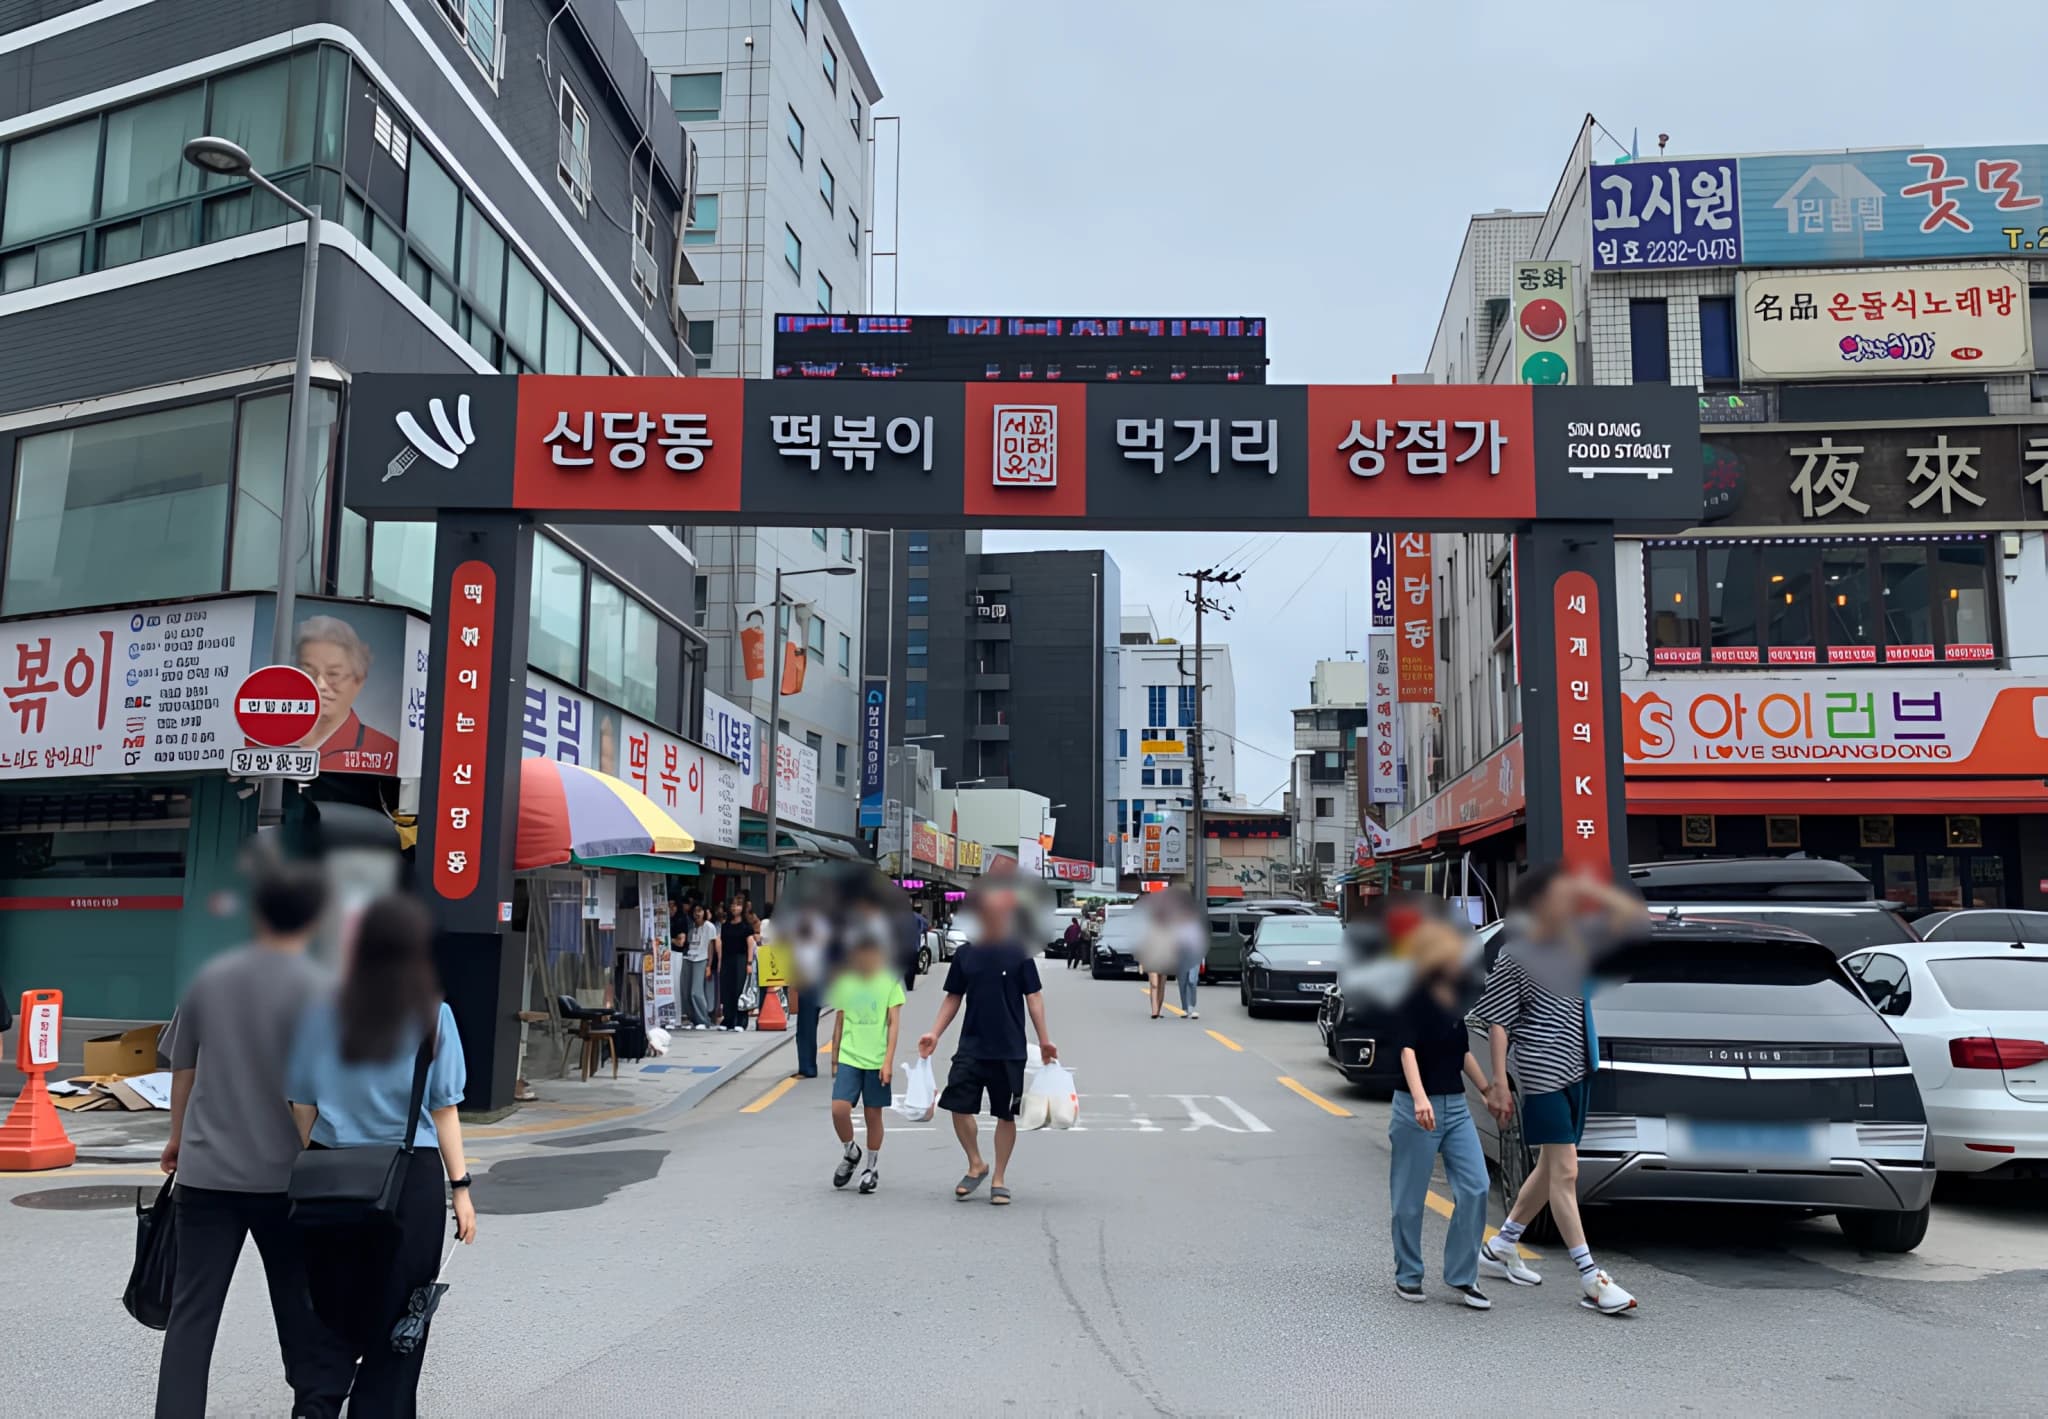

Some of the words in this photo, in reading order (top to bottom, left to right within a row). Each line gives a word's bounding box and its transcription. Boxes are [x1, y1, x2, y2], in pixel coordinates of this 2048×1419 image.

[1593, 166, 1733, 235] 고시원
[1754, 292, 1819, 323] 名品
[541, 410, 714, 471] 신당동
[768, 414, 934, 472] 떡볶이
[1115, 417, 1279, 476] 먹거리
[1337, 417, 1509, 478] 상점가
[1568, 443, 1611, 459] FOOD
[1688, 691, 1947, 740] 아이러브
[629, 731, 704, 815] 떡볶이
